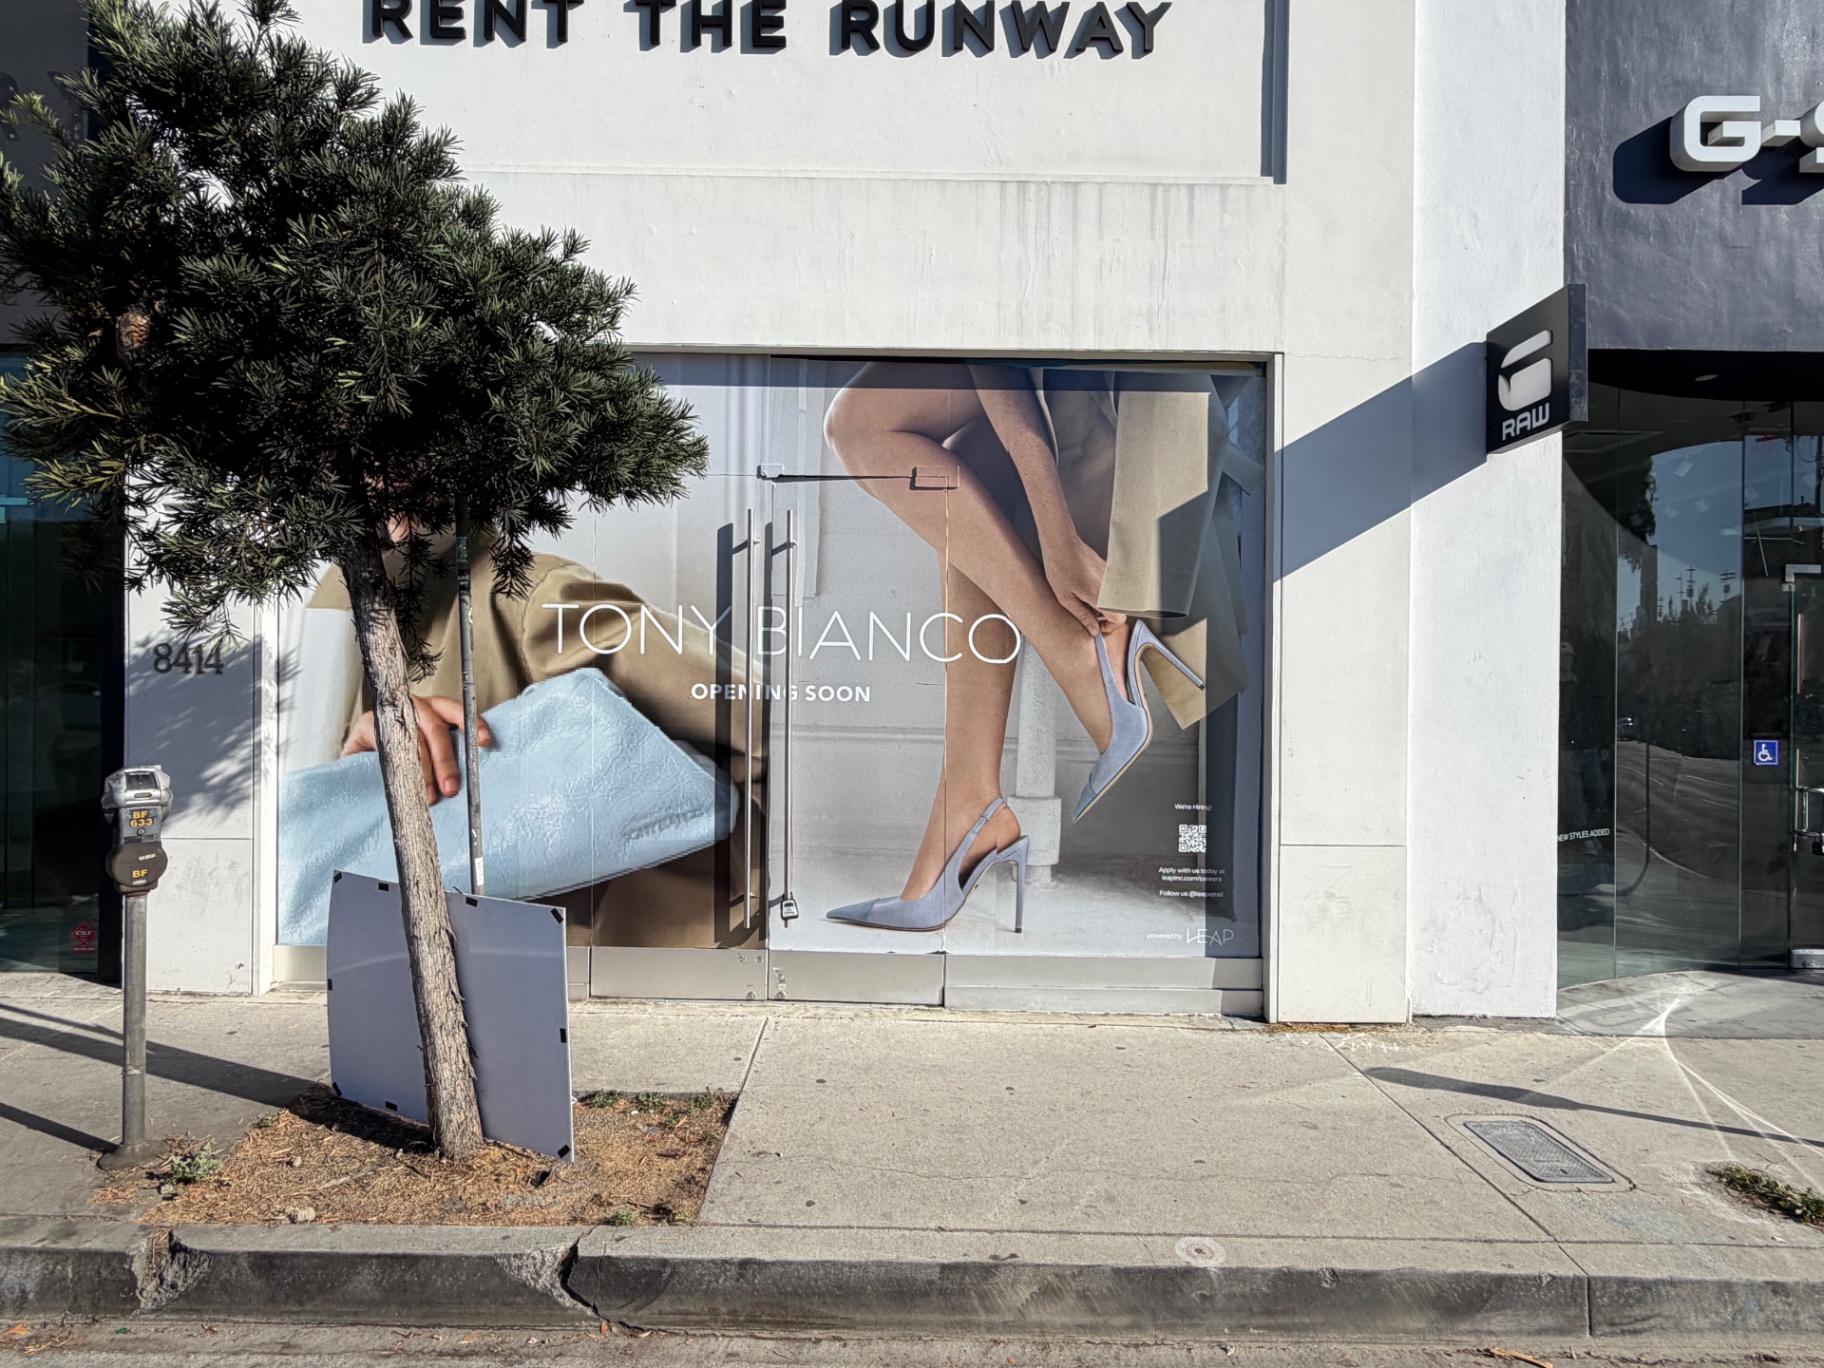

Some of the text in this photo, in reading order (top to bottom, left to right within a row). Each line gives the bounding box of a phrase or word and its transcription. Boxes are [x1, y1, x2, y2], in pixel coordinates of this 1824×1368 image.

[371, 0, 1172, 54] RENT THE RUNWAY
[1683, 95, 1824, 164] G-
[1502, 402, 1550, 441] RAW
[542, 603, 1022, 664] TONY BIANCO
[153, 642, 225, 675] 8414
[691, 682, 872, 703] OPENING SOON
[130, 818, 153, 828] 633
[132, 811, 148, 819] BF
[1570, 830, 1589, 840] STYLES
[1590, 828, 1610, 837] ADDED
[132, 869, 148, 878] BF
[1174, 933, 1183, 941] by
[1186, 928, 1234, 946] LEAP
